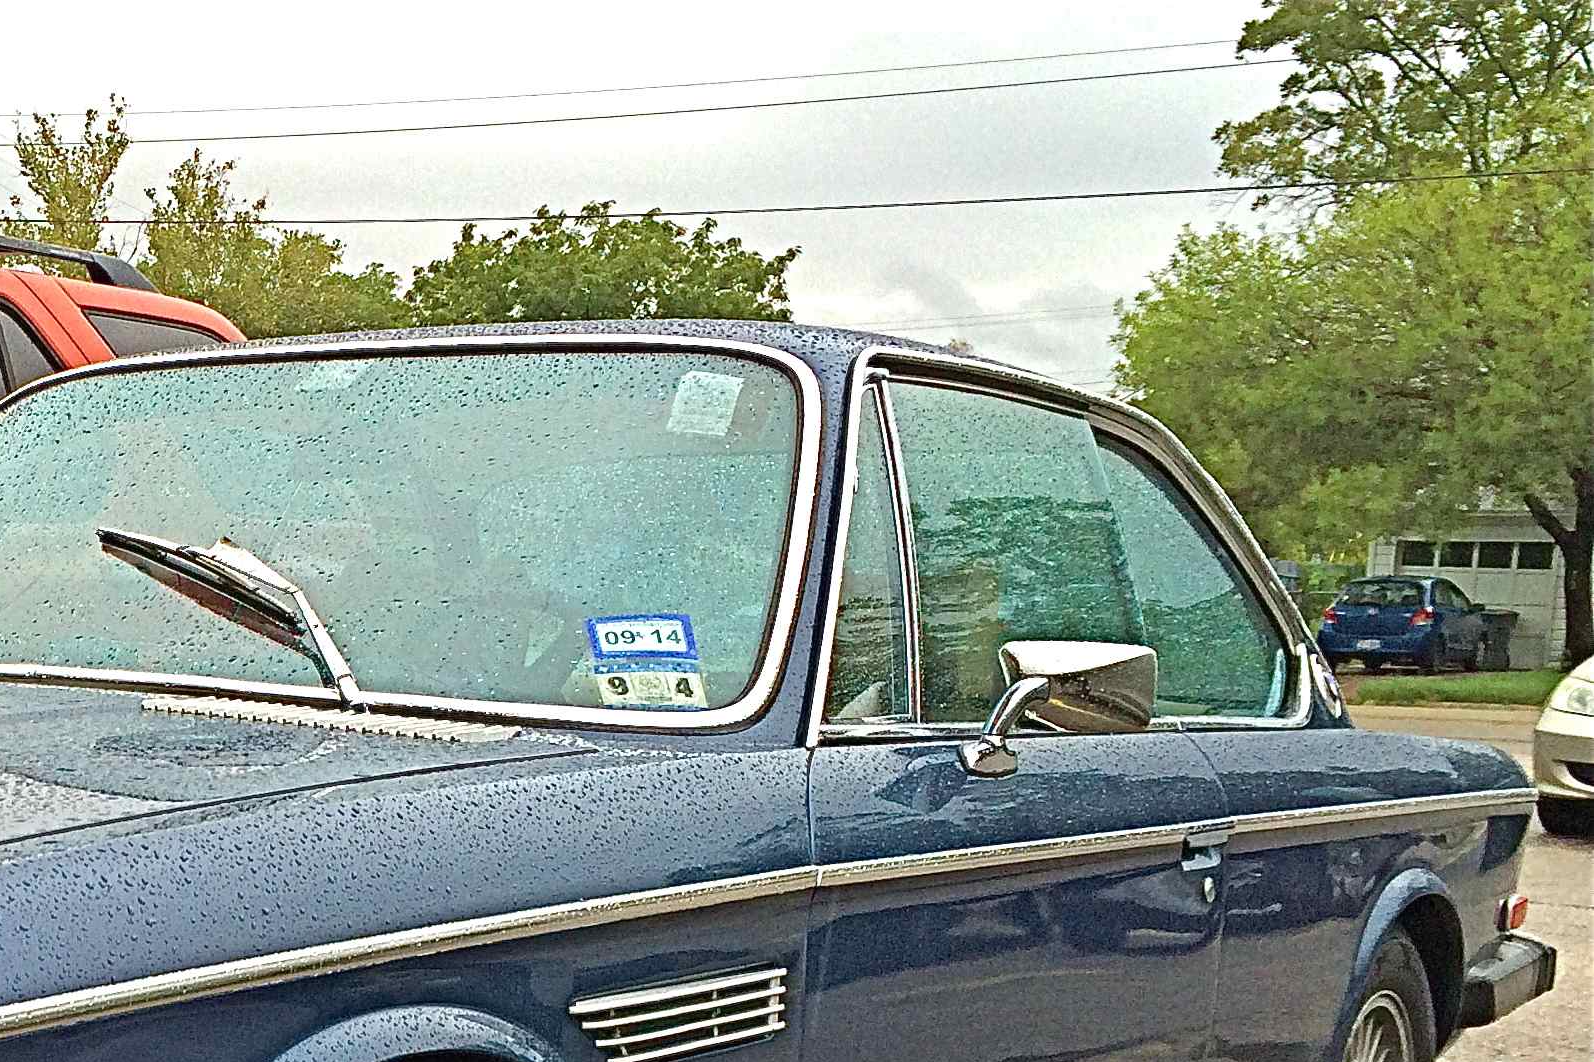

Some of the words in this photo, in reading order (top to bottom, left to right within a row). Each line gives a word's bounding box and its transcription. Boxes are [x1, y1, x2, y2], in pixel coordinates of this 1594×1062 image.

[604, 630, 636, 646] 09
[650, 629, 681, 644] 14
[607, 676, 629, 695] 9
